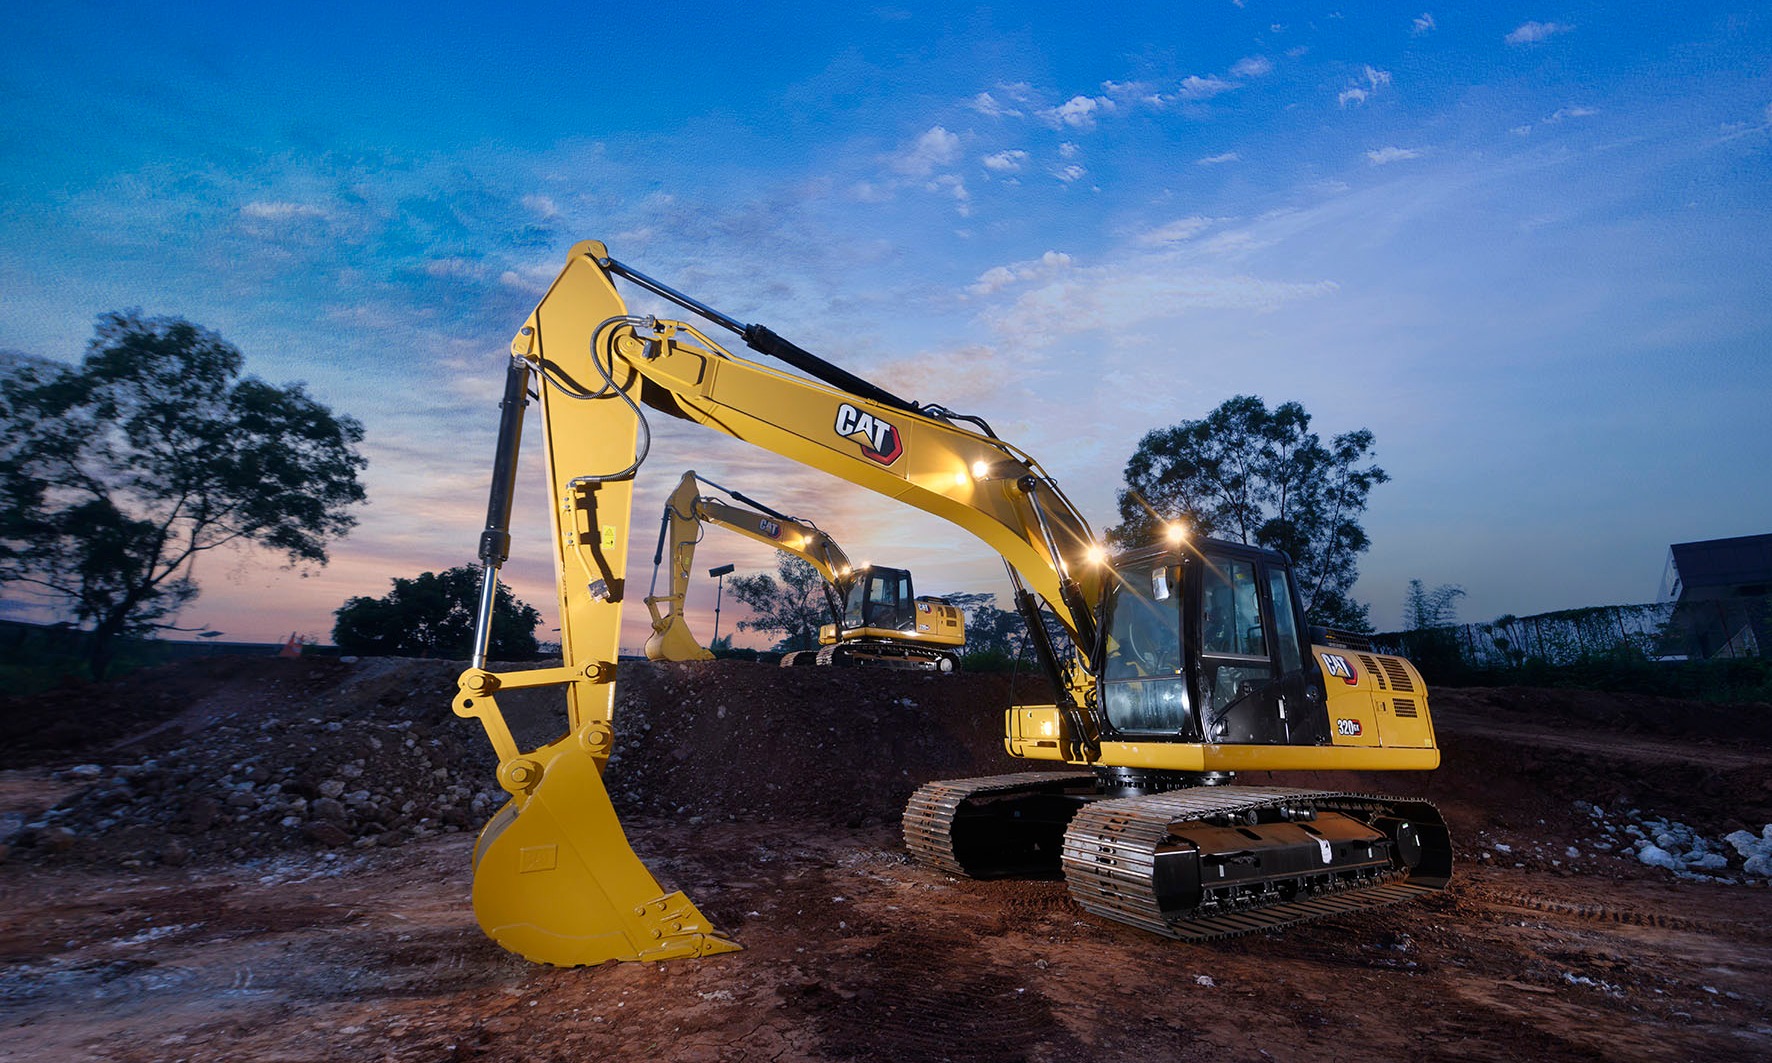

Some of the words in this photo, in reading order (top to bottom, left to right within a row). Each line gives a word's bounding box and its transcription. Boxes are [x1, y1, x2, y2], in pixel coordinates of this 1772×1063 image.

[836, 404, 891, 453] CAT
[760, 519, 778, 535] CAT
[1321, 653, 1352, 678] CAT
